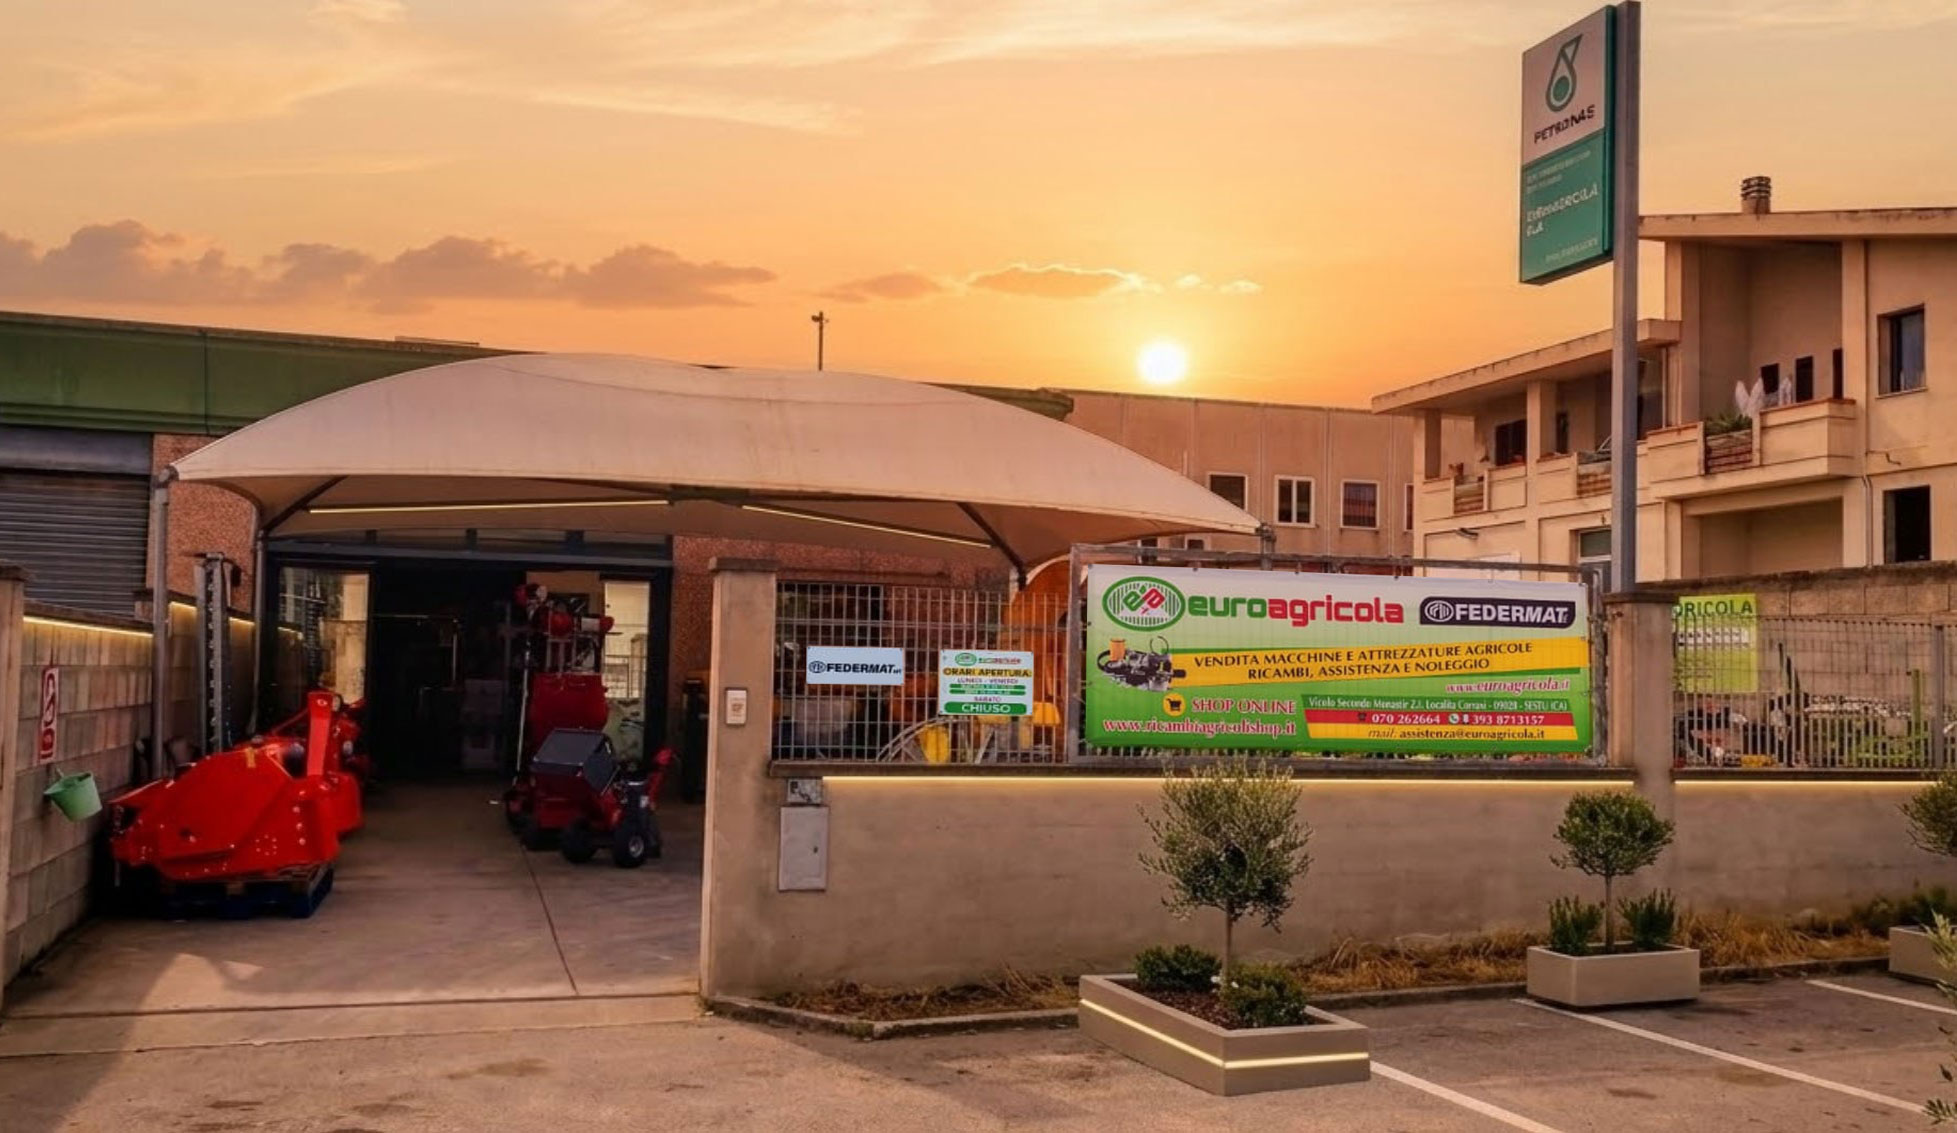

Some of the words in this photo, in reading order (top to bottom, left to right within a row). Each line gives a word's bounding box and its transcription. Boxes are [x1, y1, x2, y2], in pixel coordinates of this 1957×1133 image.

[1533, 104, 1596, 144] PETRONAS
[1188, 595, 1404, 628] euroagricola
[1455, 603, 1567, 624] FEDERMAT
[1194, 654, 1260, 667] VENDITA
[1264, 651, 1342, 665] MACCHINE
[1346, 650, 1354, 662] E
[1359, 645, 1461, 662] ATTREZZATURE
[1465, 642, 1533, 656] AGRICOLE
[827, 663, 896, 674] FEDERMAT
[943, 667, 975, 677] ORARI
[1248, 667, 1314, 680] RICAMBI,
[1318, 661, 1400, 677] ASSISTENZA
[1404, 662, 1411, 673] E
[1415, 658, 1490, 672] NOLEGGIO
[961, 704, 1011, 713] CHIUSO
[1192, 698, 1234, 713] SHOP
[1238, 699, 1296, 714] ONLINE
[1309, 697, 1336, 707] Vicolo
[1524, 701, 1549, 711] SESTU
[1372, 713, 1394, 724] 070
[1397, 714, 1441, 725] 262664
[1472, 714, 1493, 725] 393
[1496, 715, 1545, 725] 8713157
[1103, 717, 1296, 739] www.ricambiagricolishop.it
[1400, 728, 1545, 741] assistenza@euroagricola.it
